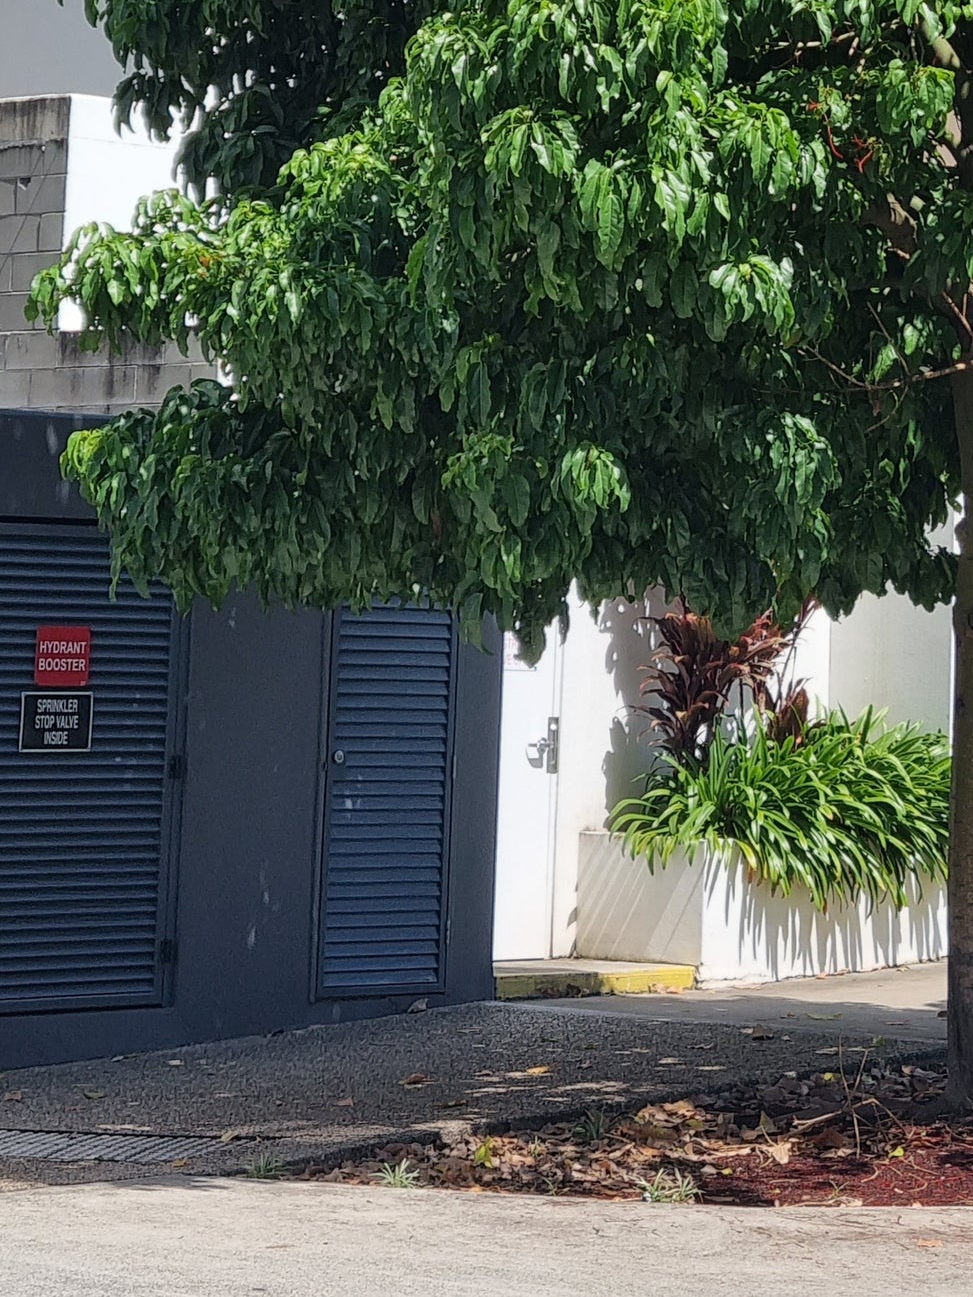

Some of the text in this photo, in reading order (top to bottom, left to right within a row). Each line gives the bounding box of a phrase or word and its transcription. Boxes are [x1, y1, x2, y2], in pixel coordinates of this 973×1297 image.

[39, 641, 87, 654] HYDRANT
[38, 658, 86, 671] BOOSTER
[37, 699, 78, 713] SPRINKLER
[35, 715, 79, 729] STOP VALVE
[43, 731, 68, 745] INSIDE
